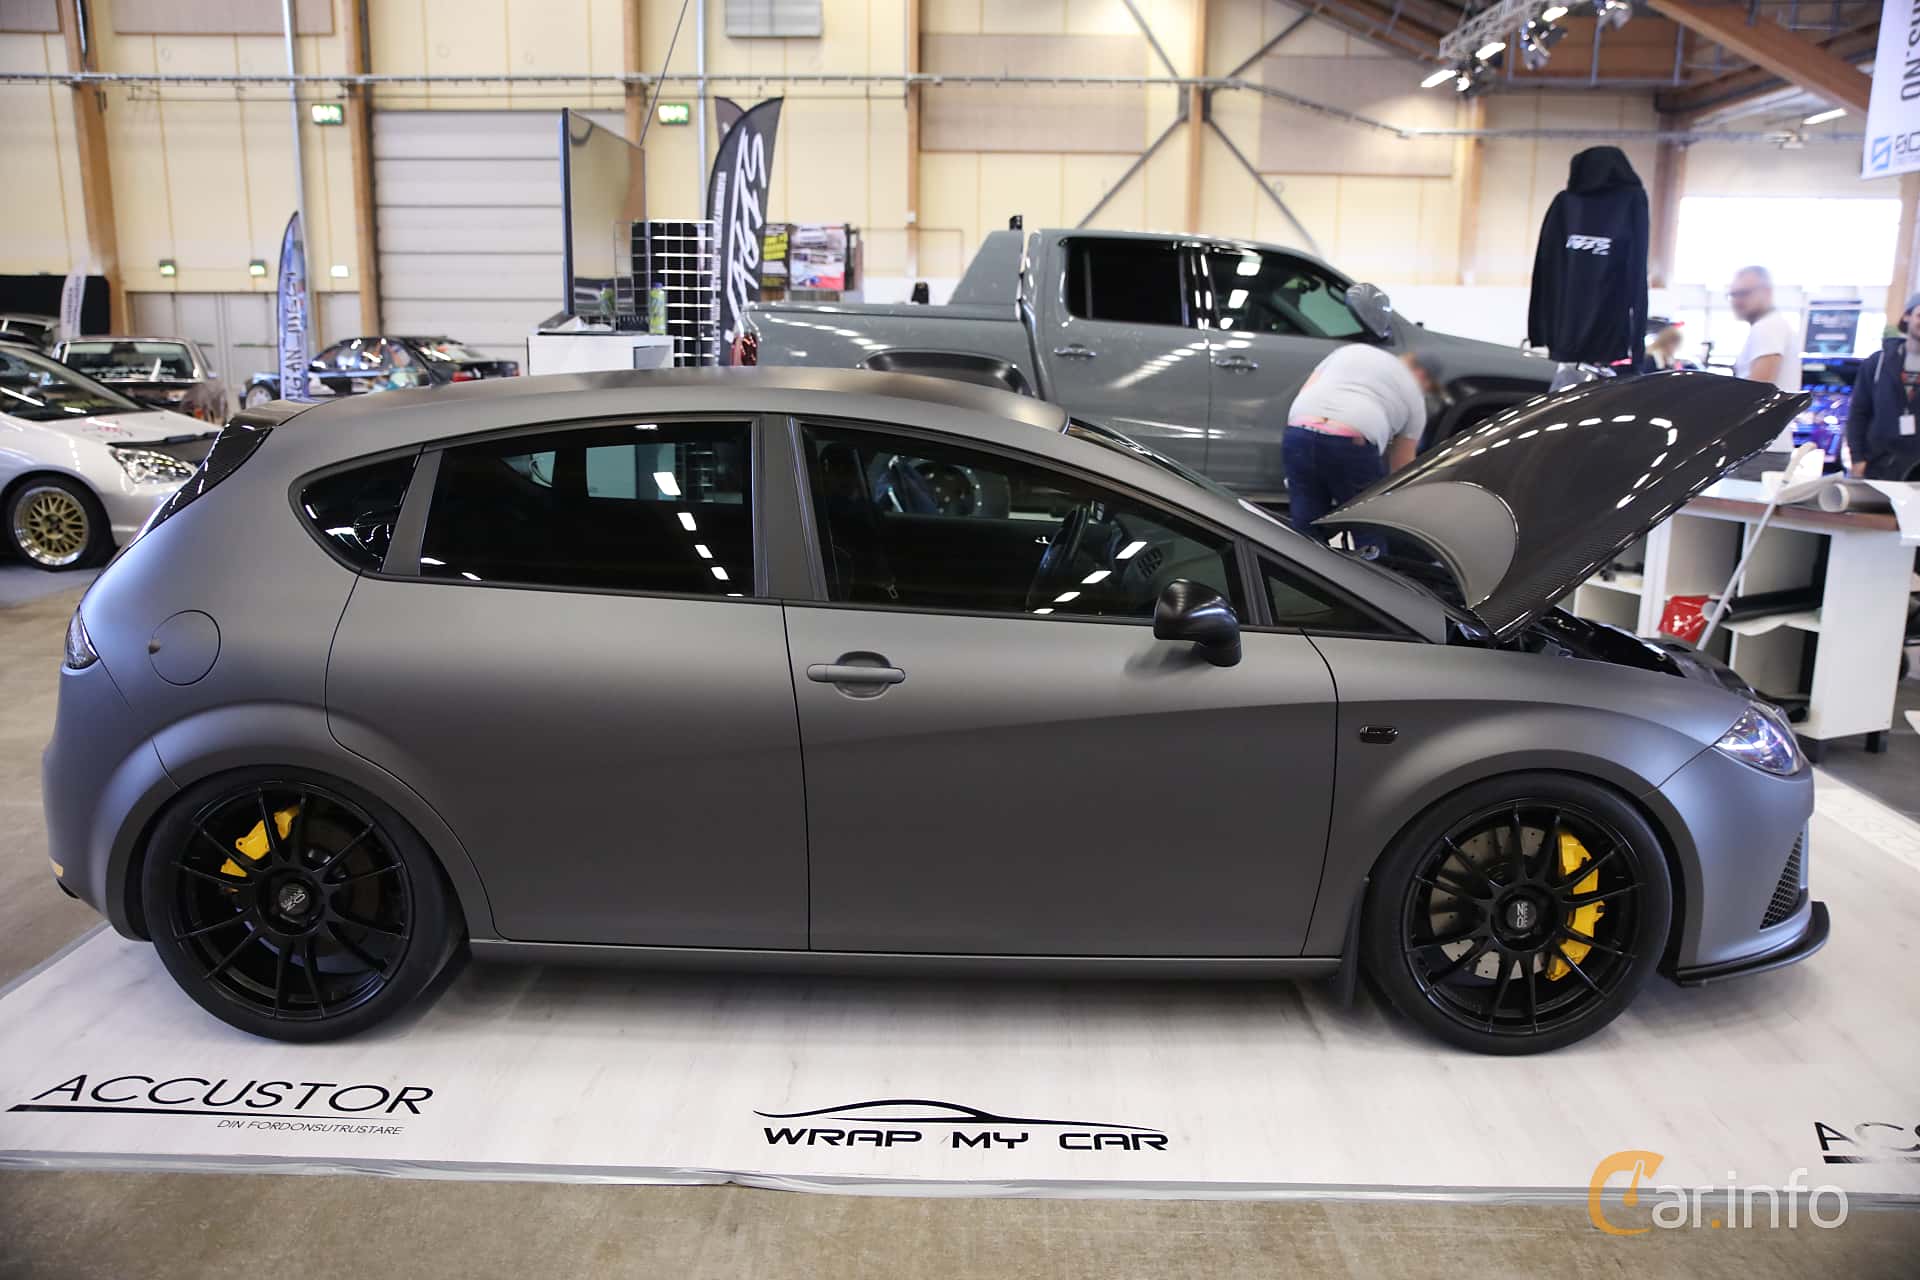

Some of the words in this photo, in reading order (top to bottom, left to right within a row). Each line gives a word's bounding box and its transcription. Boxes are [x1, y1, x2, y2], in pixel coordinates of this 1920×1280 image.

[31, 1074, 434, 1115] ACCUSTOR
[217, 1119, 246, 1129] DIN
[247, 1121, 404, 1135] FORDONSUTRUSTARE
[763, 1127, 923, 1147] WRAP
[952, 1131, 1030, 1149] MY
[1059, 1133, 1170, 1152] CAR
